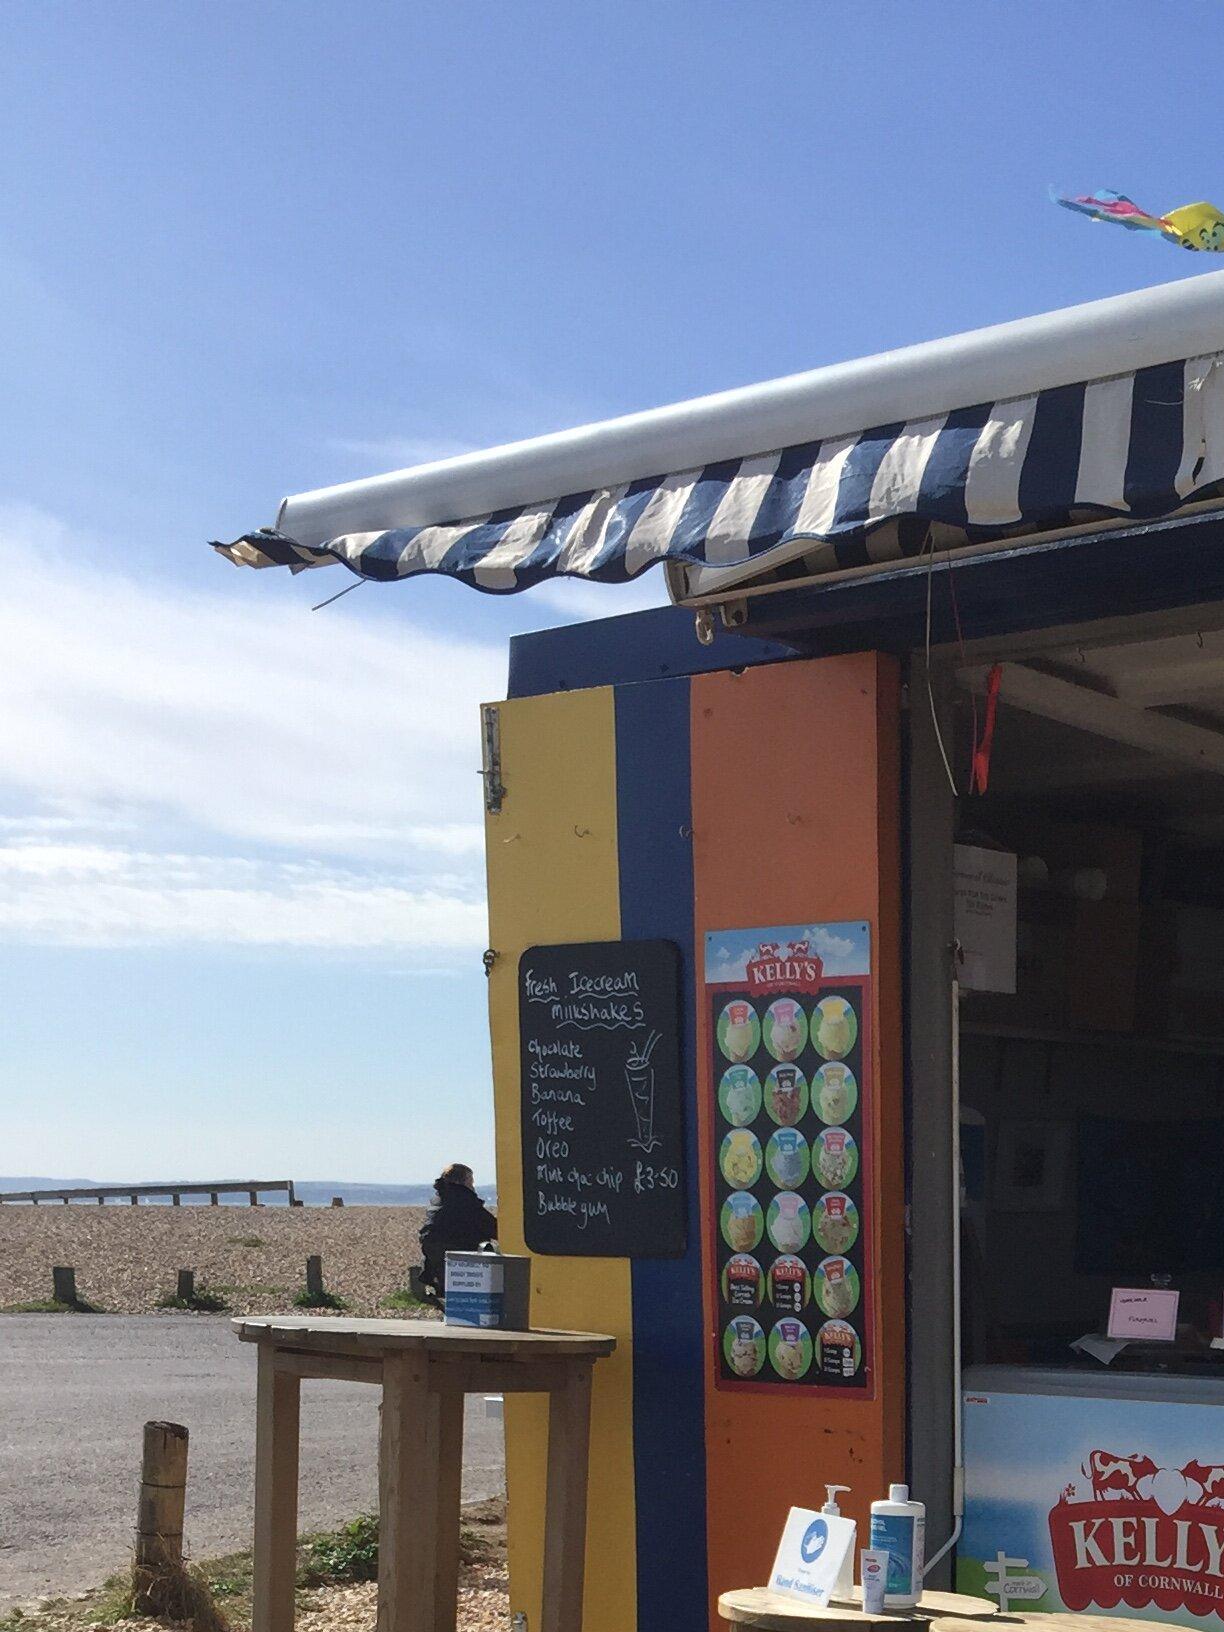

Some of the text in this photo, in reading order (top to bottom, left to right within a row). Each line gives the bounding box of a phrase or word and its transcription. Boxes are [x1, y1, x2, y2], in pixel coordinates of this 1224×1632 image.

[753, 961, 816, 985] KELLY'S
[531, 1083, 586, 1106] Banana
[532, 1110, 575, 1134] Toffee
[536, 1140, 569, 1159] Oreo
[1113, 1574, 1224, 1600] OF CORNWALL
